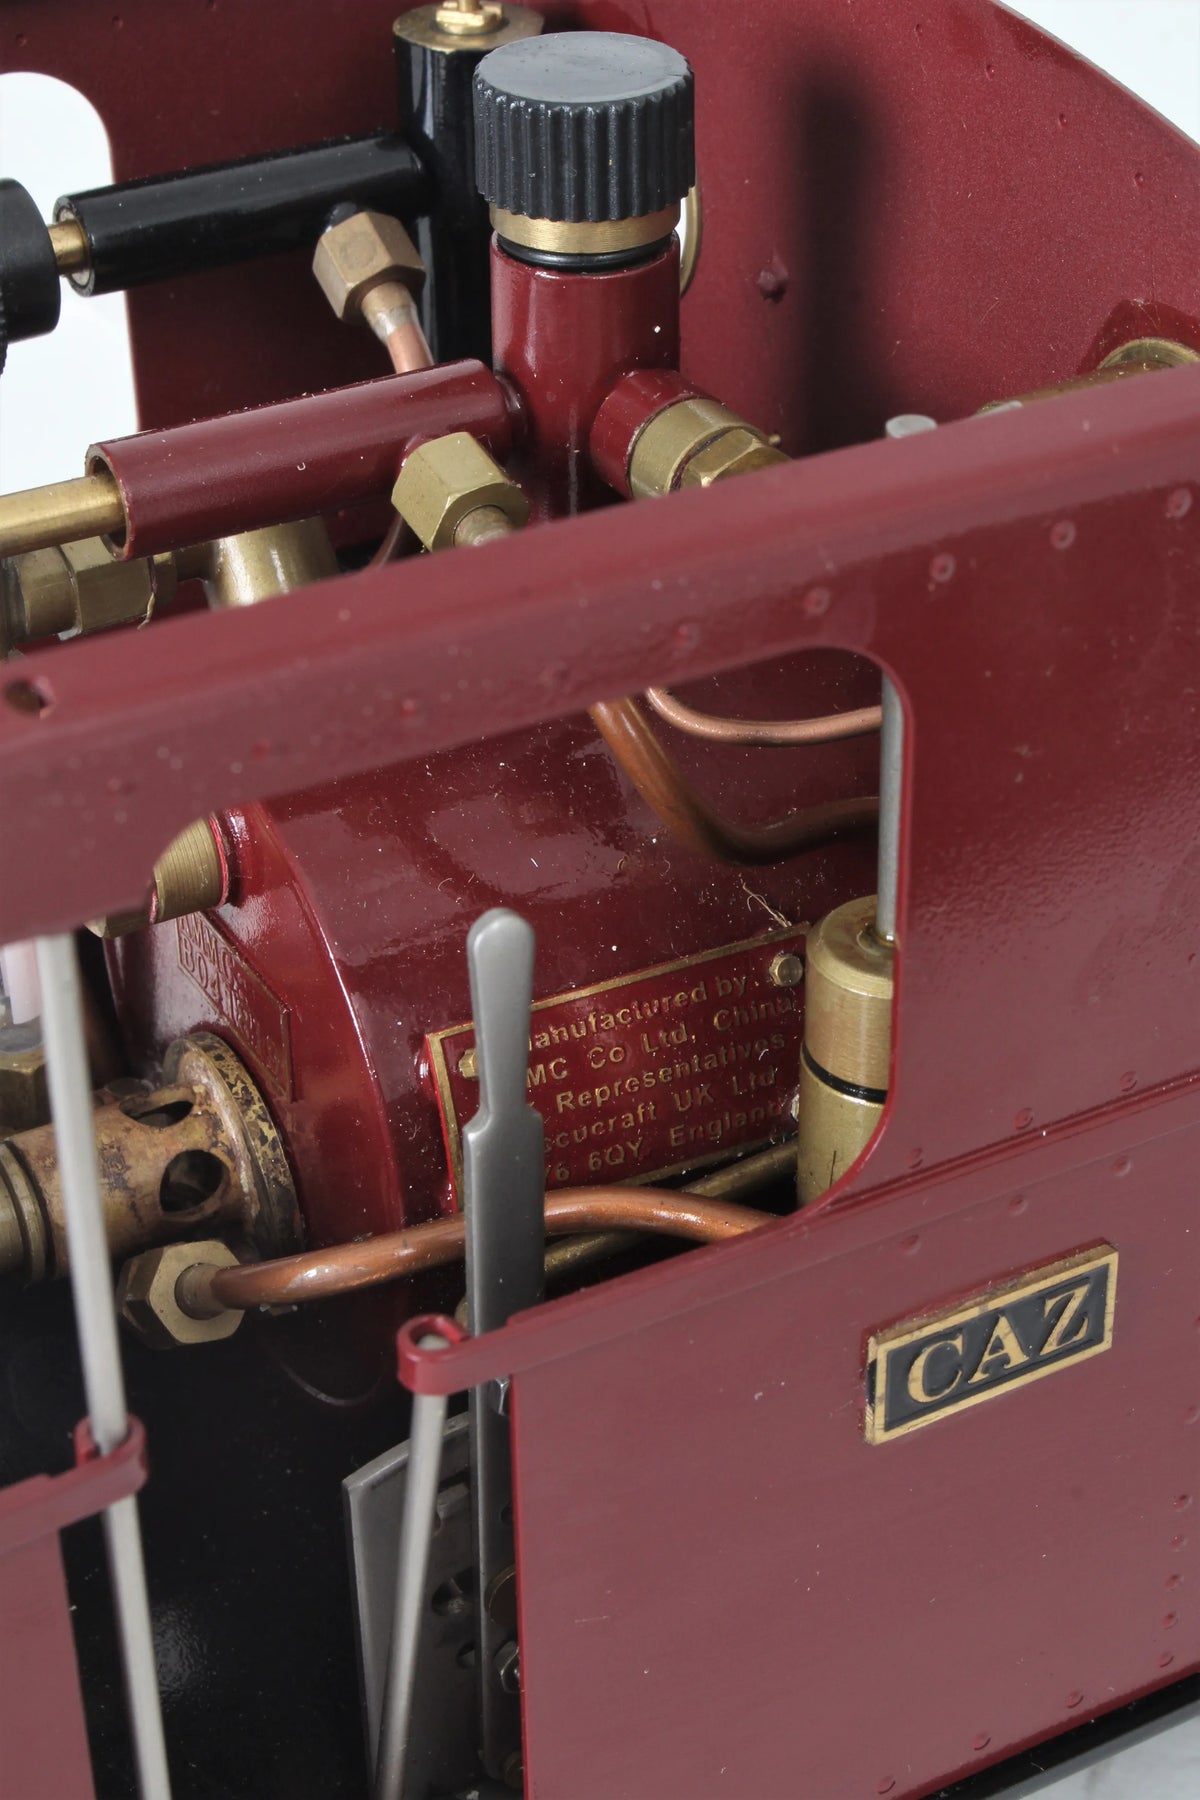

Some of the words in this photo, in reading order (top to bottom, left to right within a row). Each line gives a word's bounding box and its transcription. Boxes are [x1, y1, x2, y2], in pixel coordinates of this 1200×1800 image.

[528, 981, 707, 1052] anufactured
[589, 1046, 625, 1069] Co
[713, 997, 793, 1031] China
[543, 1102, 657, 1154] ccucraft
[674, 1083, 714, 1112] UK
[732, 1065, 776, 1096] Ltd
[556, 1033, 785, 1114] Representatives
[906, 1283, 1091, 1404] CAZ
